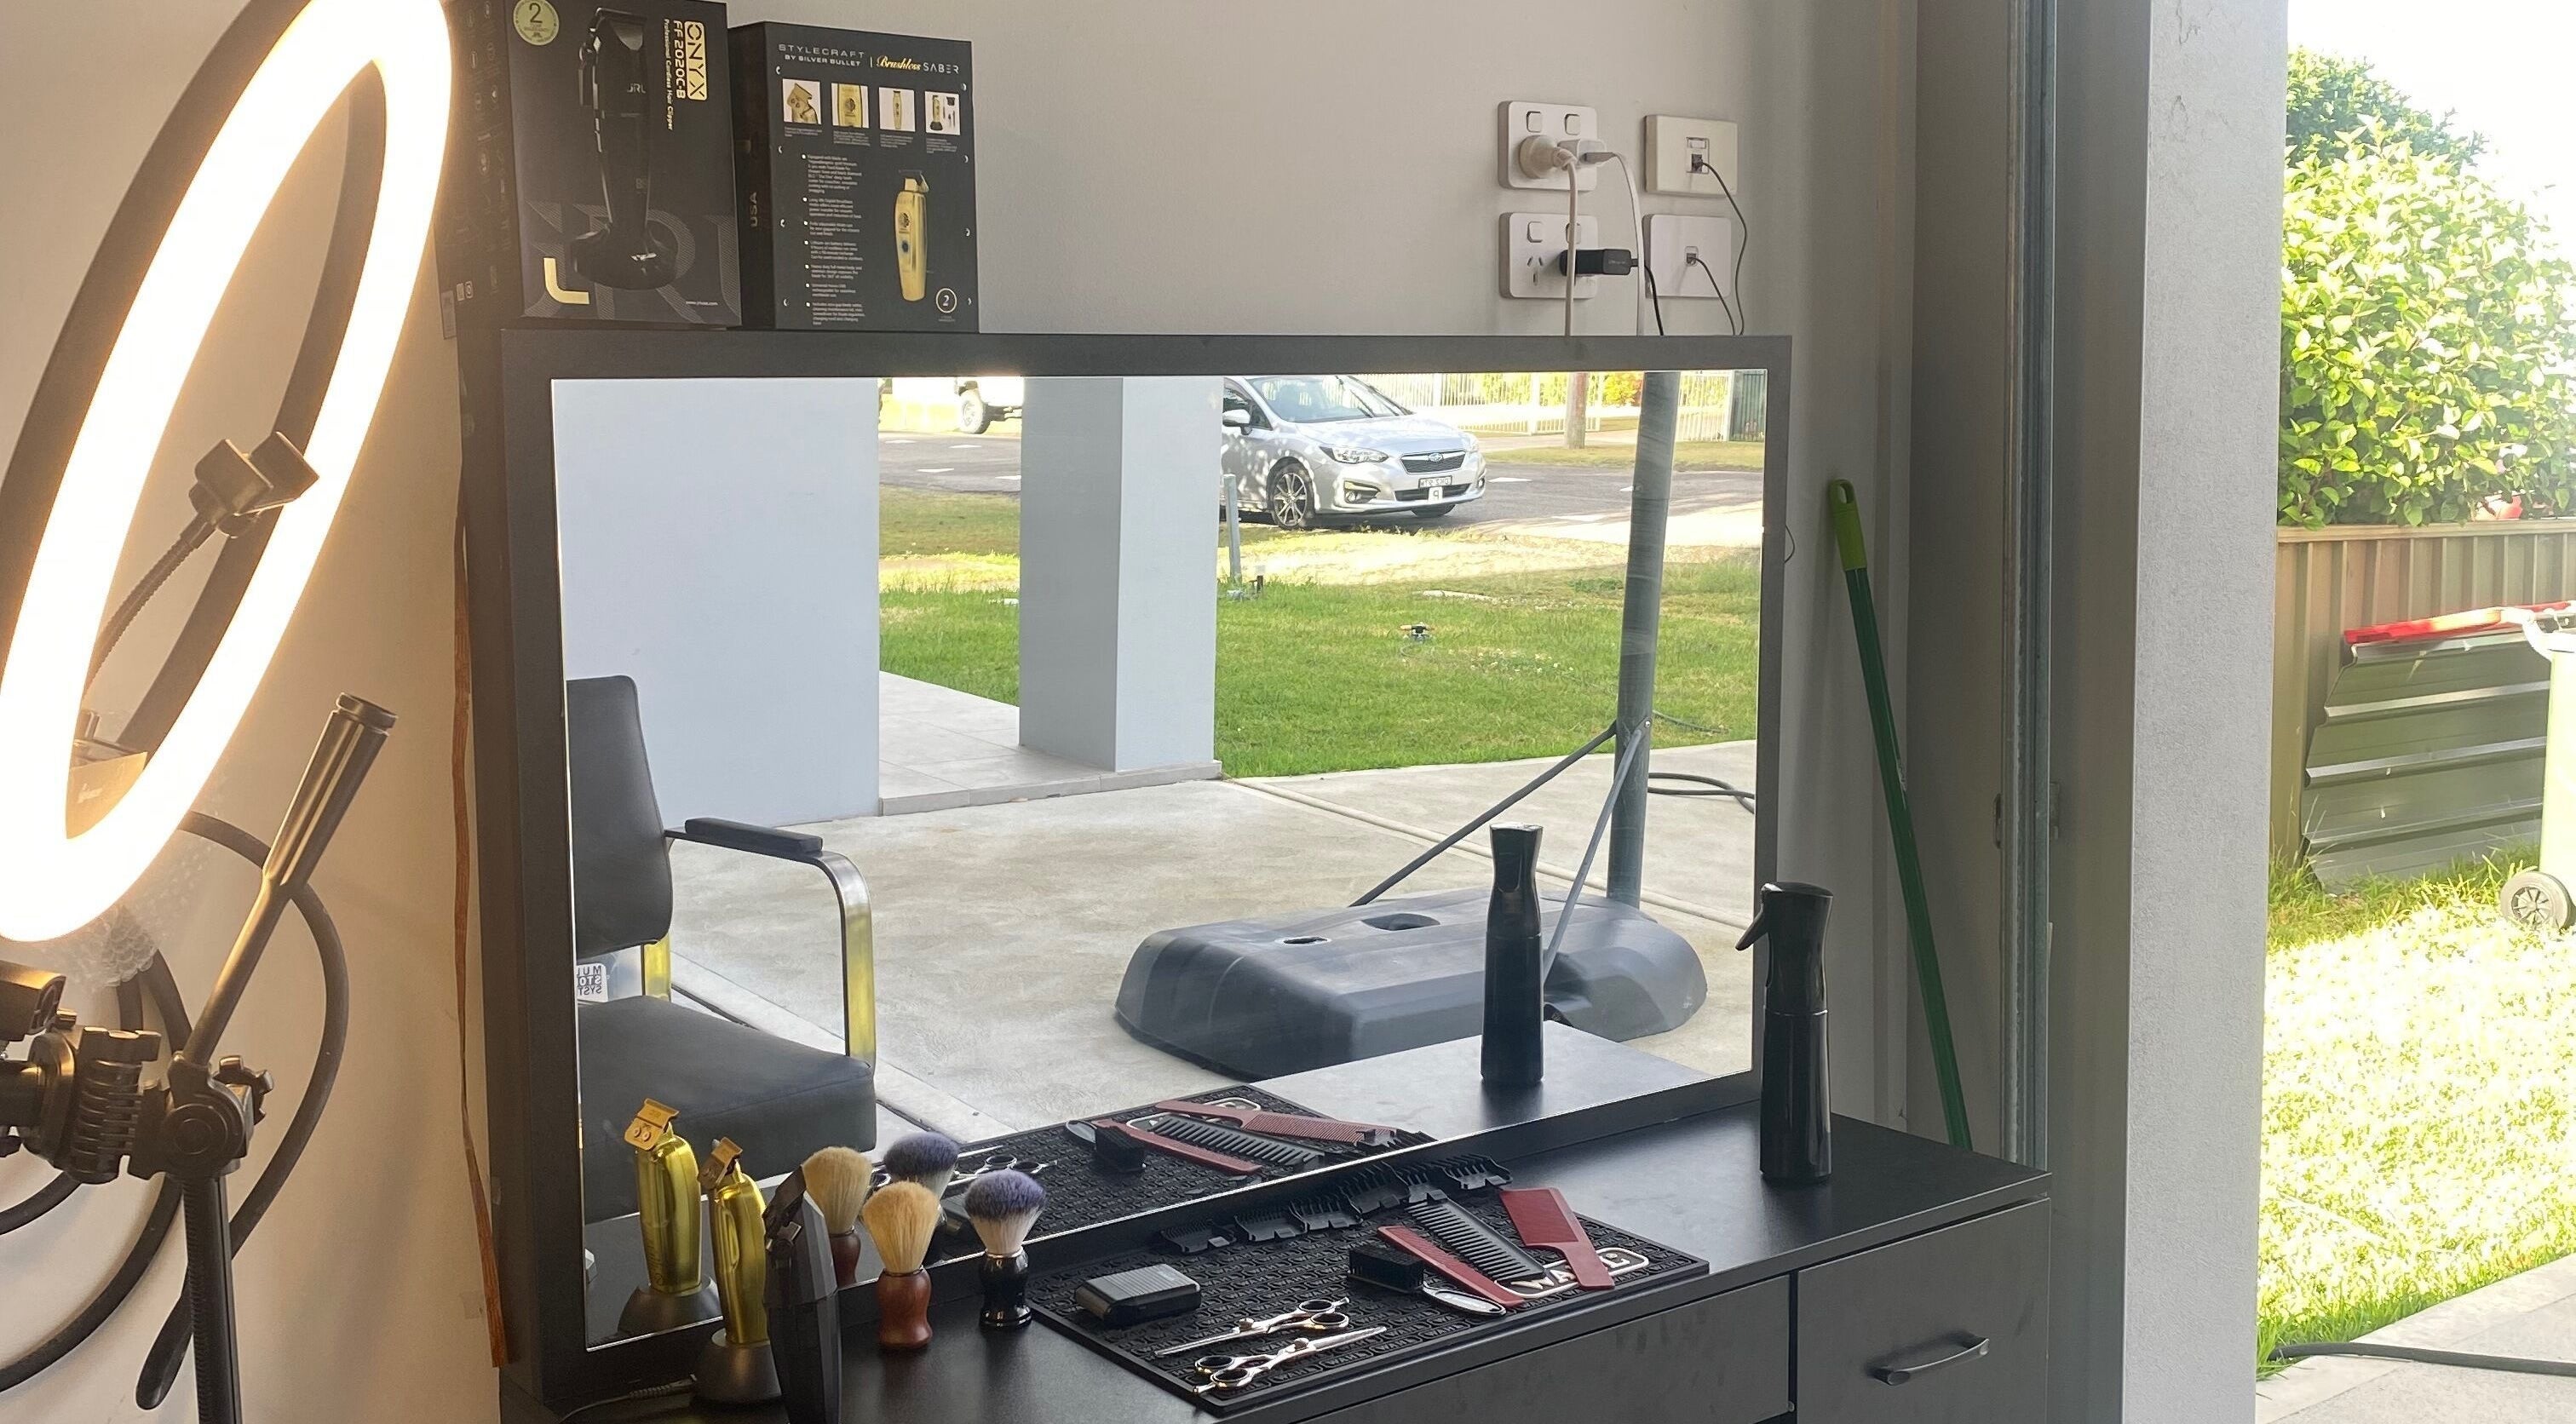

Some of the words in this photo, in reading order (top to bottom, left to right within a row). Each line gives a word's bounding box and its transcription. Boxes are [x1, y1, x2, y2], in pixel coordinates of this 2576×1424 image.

[529, 3, 543, 24] 2
[687, 24, 705, 97] ONYX
[778, 43, 865, 59] STYLECRAFT
[798, 55, 828, 64] SILVER
[877, 55, 921, 72] Brushless
[923, 62, 959, 74] SABER
[627, 83, 647, 94] JRL
[749, 192, 758, 227] USA
[942, 294, 950, 307] 2
[1510, 1255, 1631, 1290] WAL
